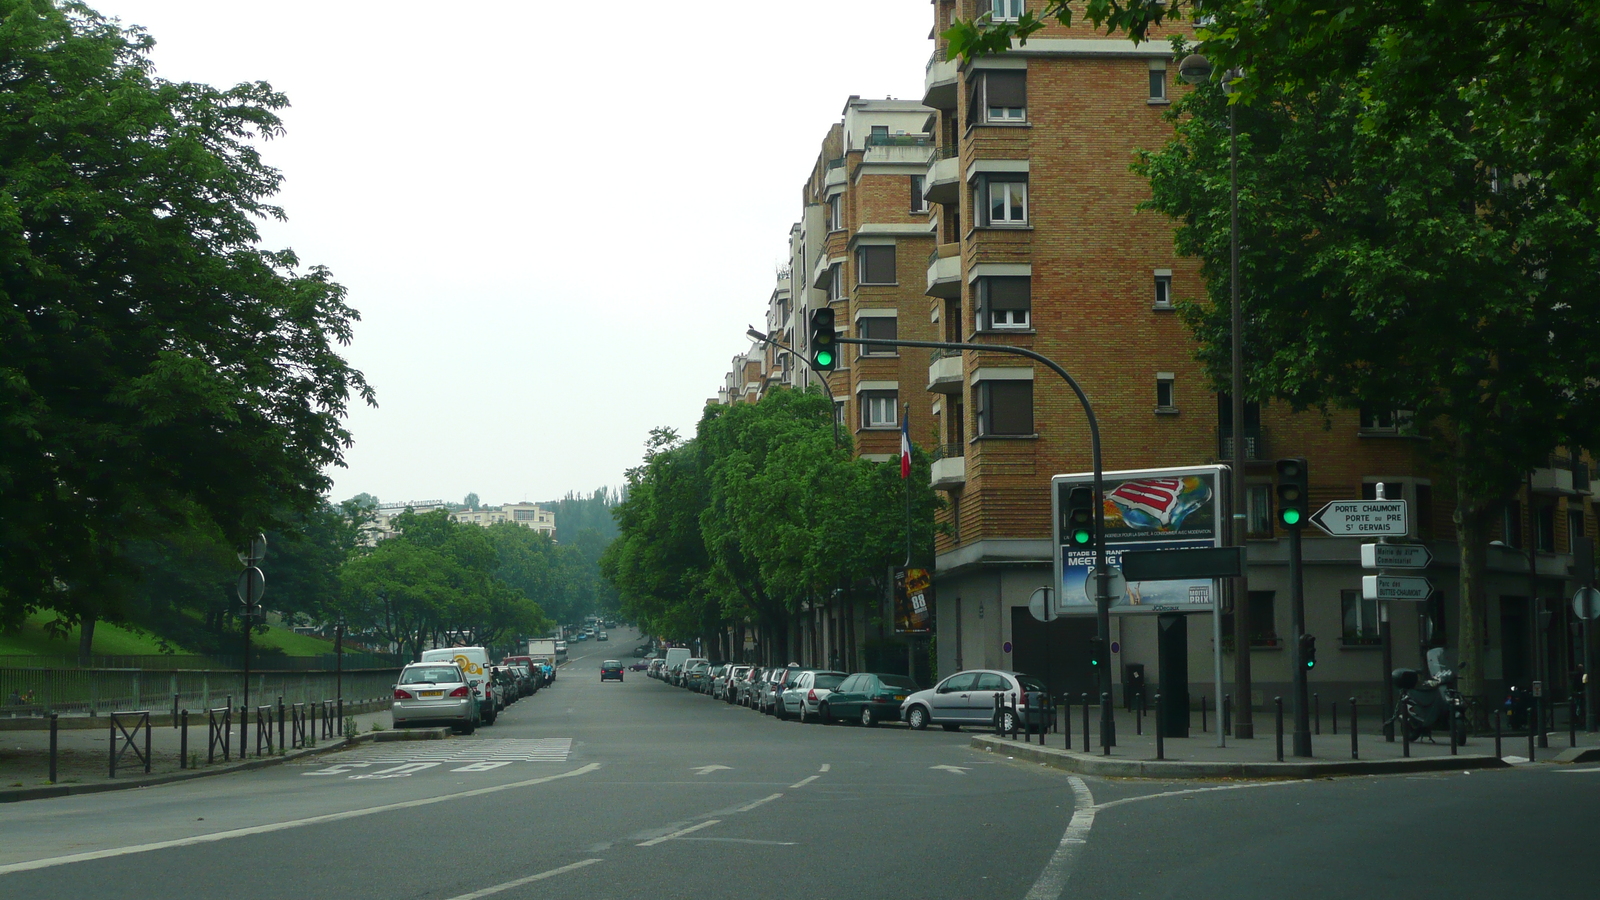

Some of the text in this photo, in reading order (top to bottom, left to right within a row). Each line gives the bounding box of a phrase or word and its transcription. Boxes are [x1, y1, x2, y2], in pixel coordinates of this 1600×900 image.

[1335, 504, 1401, 513] PORTE CHAUMONT
[1345, 514, 1370, 522] PORTE
[1358, 523, 1391, 531] GERVAIS
[1377, 556, 1412, 564] Commissariat
[1392, 580, 1401, 588] des
[1379, 588, 1422, 596] BUTTES-CHAUMONT
[911, 593, 926, 609] 88
[1189, 596, 1209, 604] PRIX
